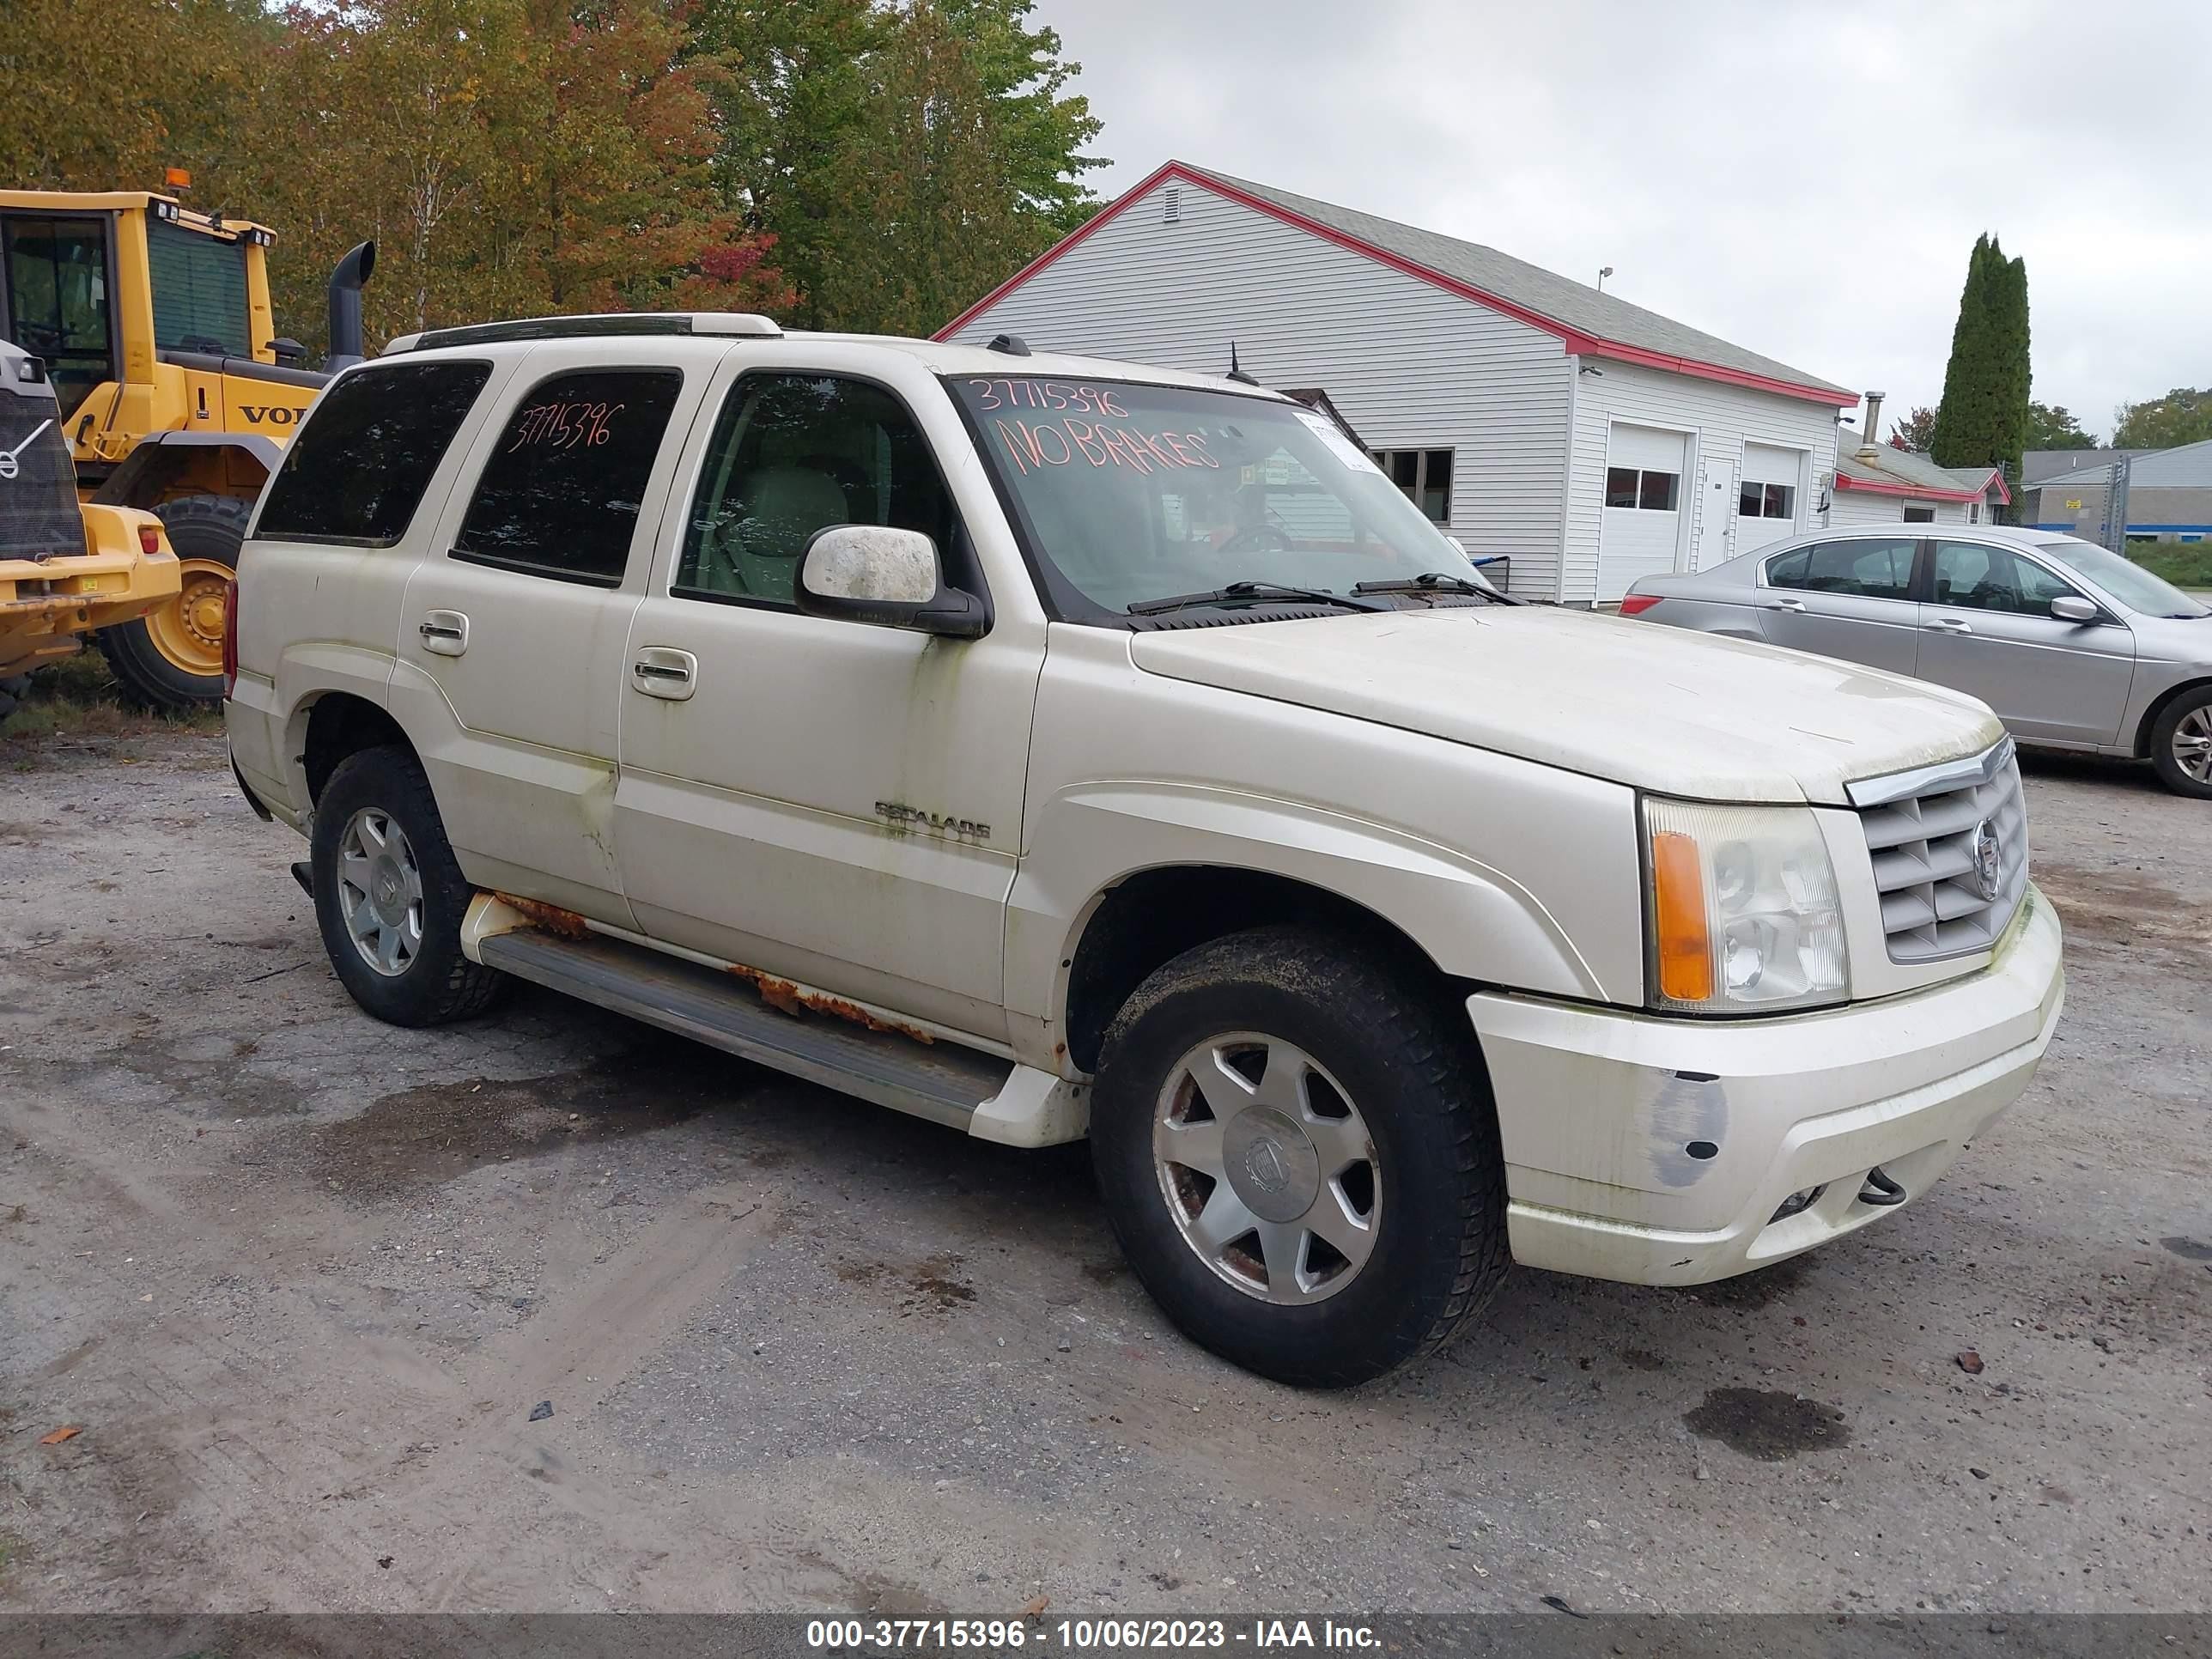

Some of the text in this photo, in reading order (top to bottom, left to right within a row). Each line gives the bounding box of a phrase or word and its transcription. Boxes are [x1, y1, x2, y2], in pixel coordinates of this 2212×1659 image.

[969, 380, 1128, 417] 37715396
[507, 403, 625, 453] 37715396
[995, 418, 1219, 476] NO BRAKES
